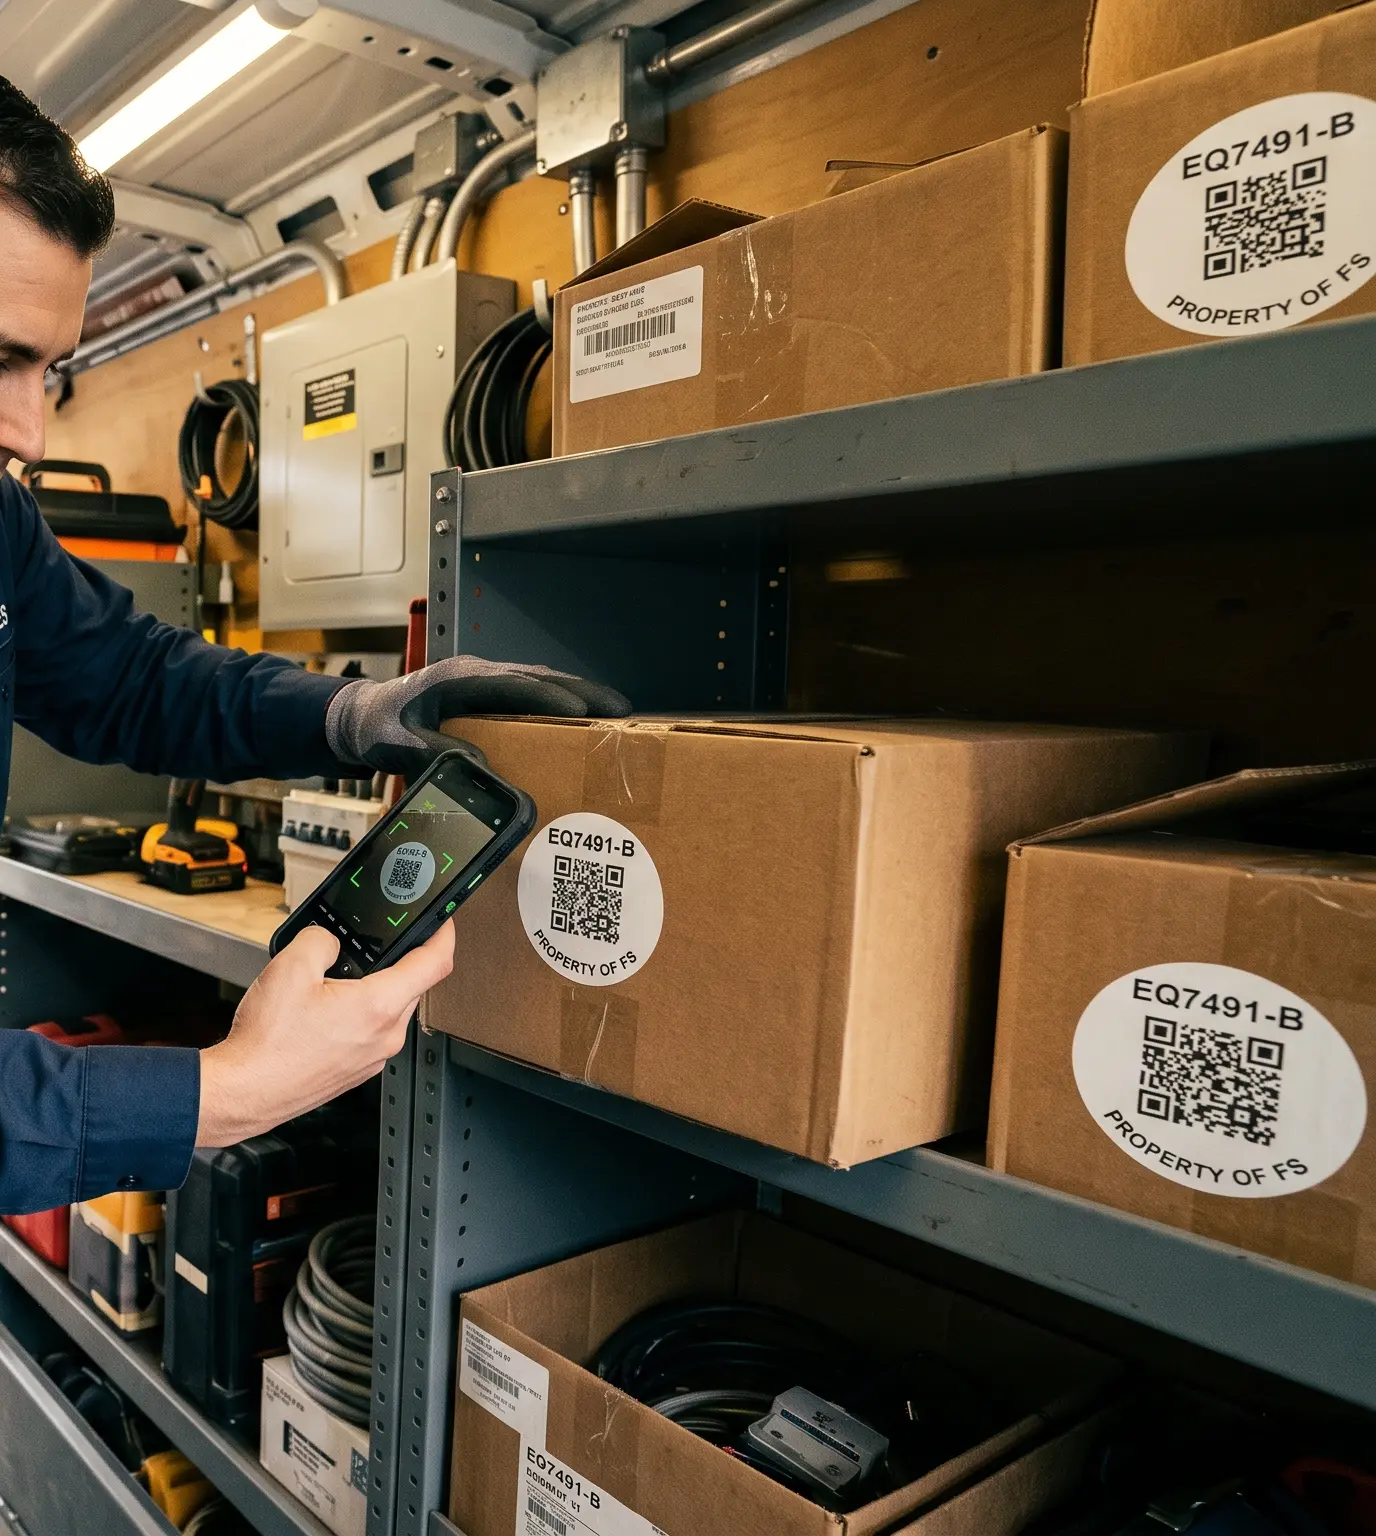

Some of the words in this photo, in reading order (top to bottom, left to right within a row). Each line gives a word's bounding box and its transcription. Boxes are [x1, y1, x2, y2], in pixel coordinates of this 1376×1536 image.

[1182, 111, 1355, 180] EQ7491-B
[1166, 294, 1293, 326] PROPERTY
[1300, 278, 1333, 306] OF
[1335, 252, 1371, 282] FS
[548, 827, 636, 858] EQ7491-B
[533, 928, 597, 977] PROPERTY
[599, 960, 618, 977] OF
[619, 950, 637, 969] FS
[1132, 977, 1305, 1031] EQ7491-B
[1102, 1108, 1225, 1184] PROPERTY
[1232, 1167, 1267, 1186] OF
[1272, 1157, 1309, 1181] FS
[526, 1446, 601, 1510] EQ7491-B
